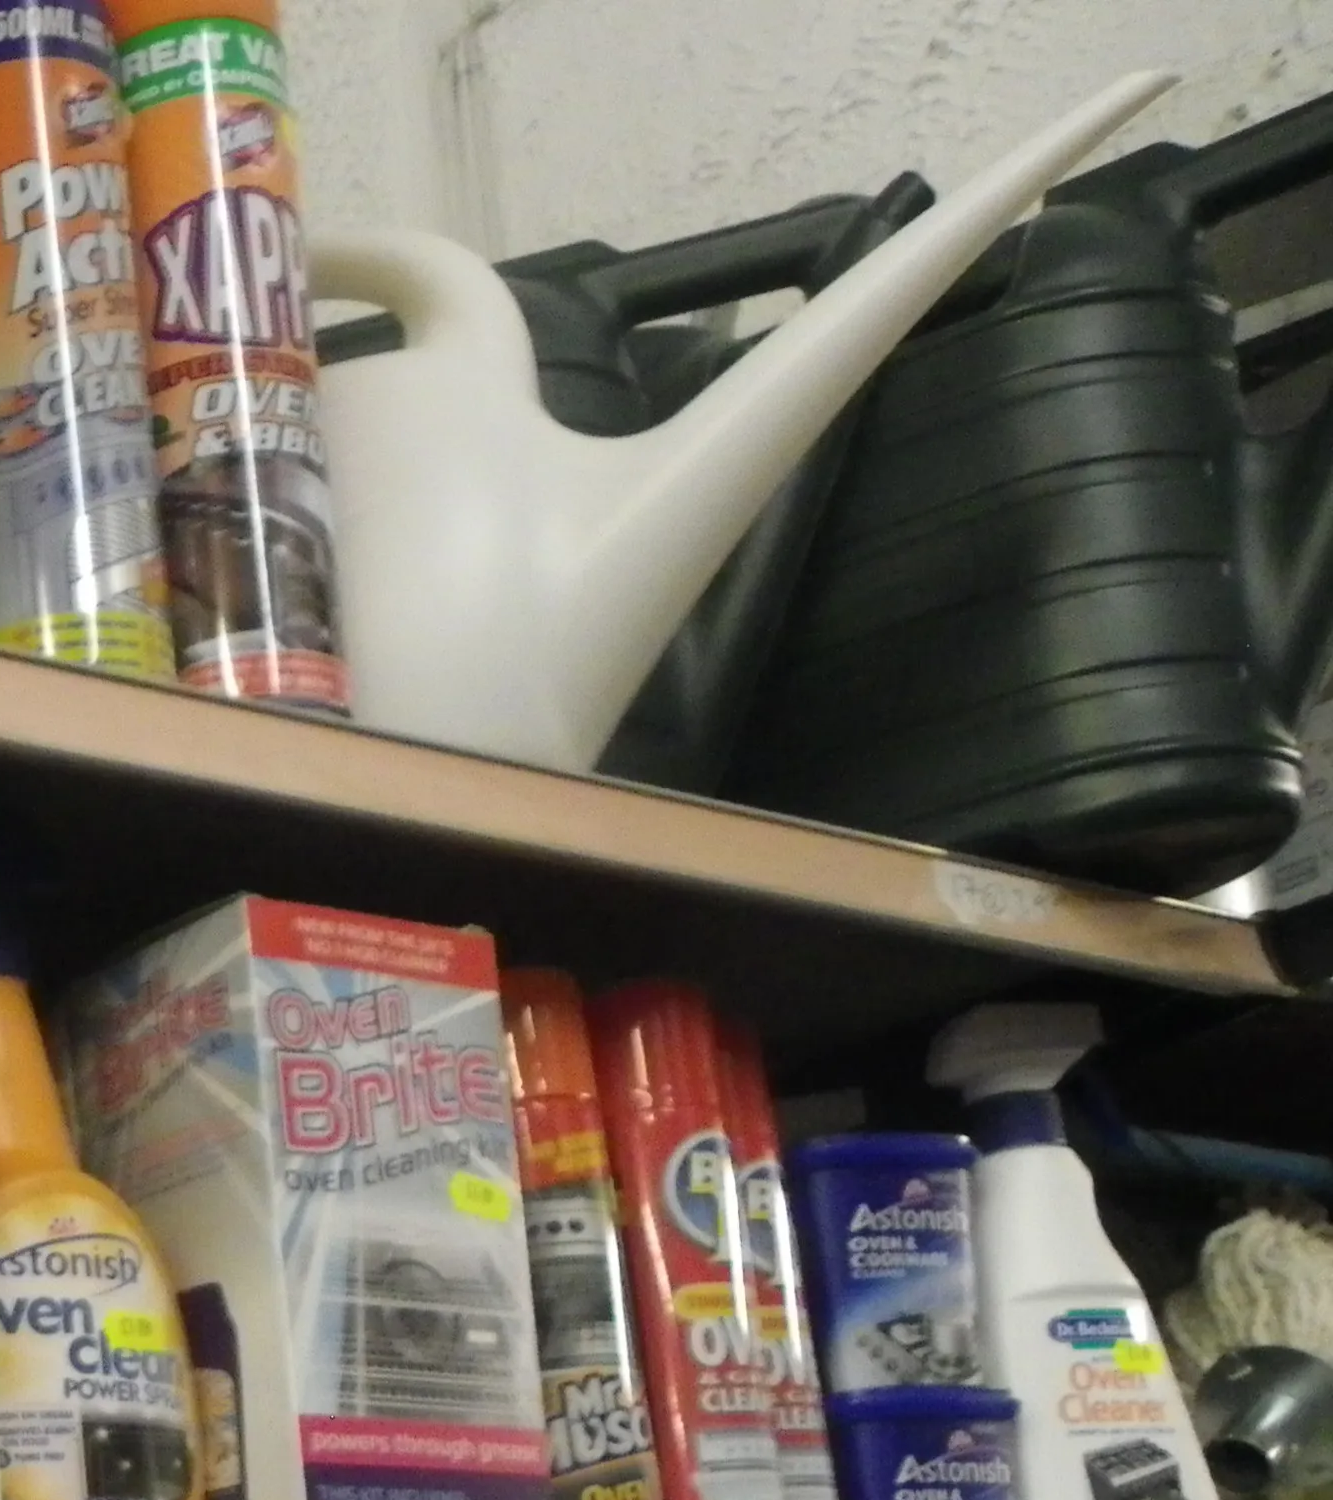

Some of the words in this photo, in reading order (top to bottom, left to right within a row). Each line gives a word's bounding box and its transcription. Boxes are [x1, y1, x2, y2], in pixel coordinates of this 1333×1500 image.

[268, 985, 411, 1050] Oven
[277, 1029, 508, 1154] Brite
[850, 1202, 968, 1232] Astonish
[64, 1378, 140, 1401] POWER
[895, 1454, 1011, 1484] Astonish
